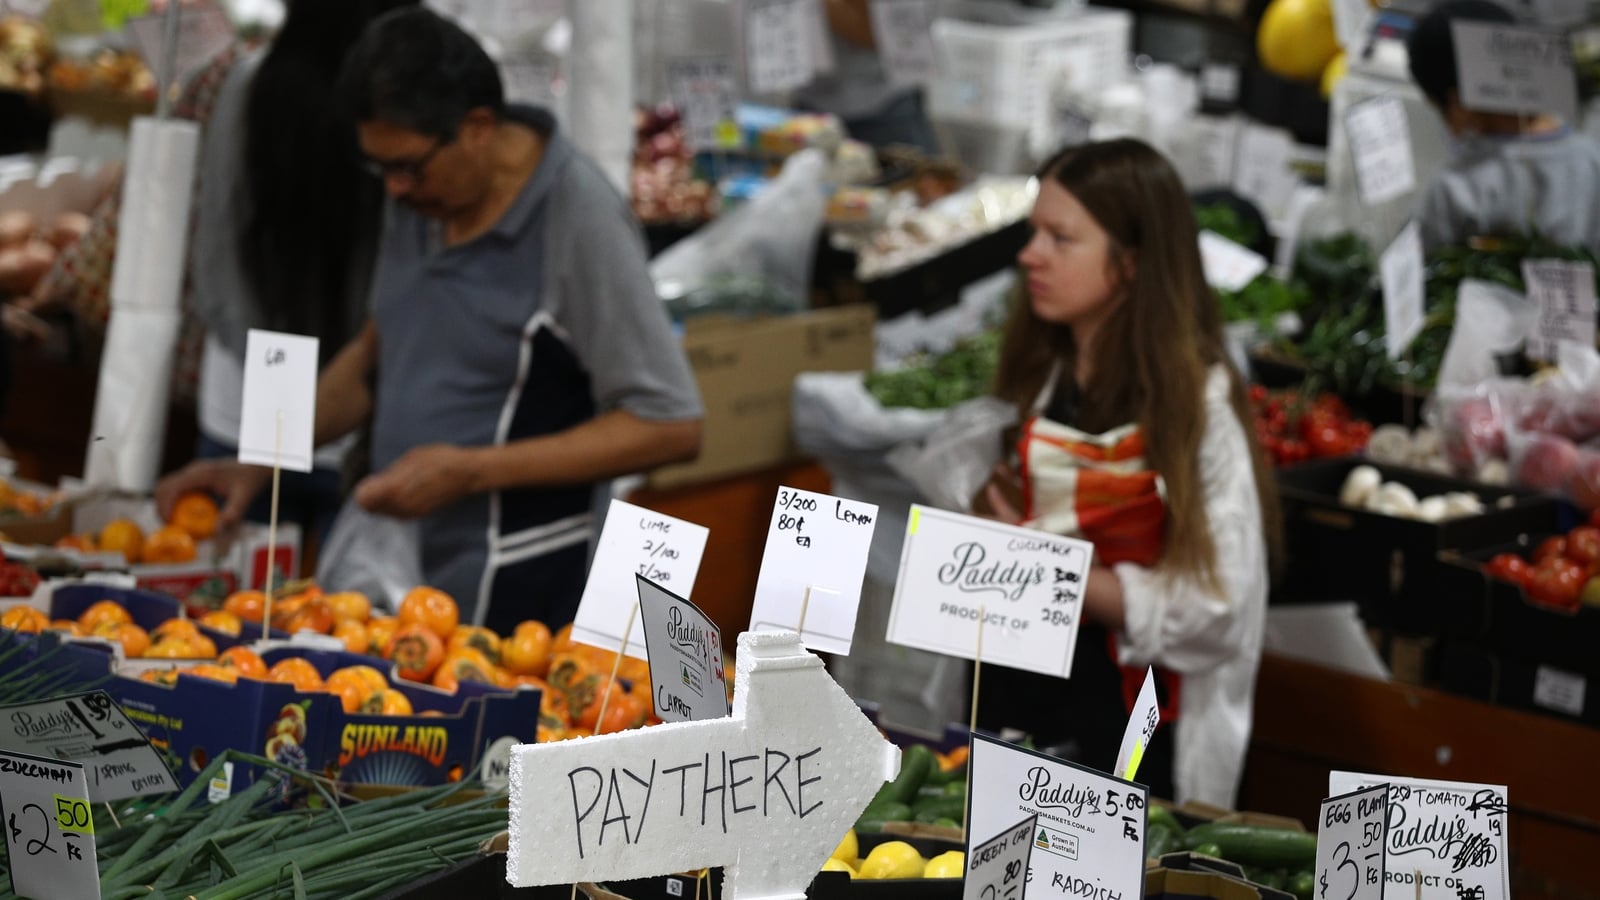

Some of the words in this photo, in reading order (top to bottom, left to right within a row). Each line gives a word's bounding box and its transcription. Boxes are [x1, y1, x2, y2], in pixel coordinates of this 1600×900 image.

[779, 490, 817, 512] 3/200
[938, 542, 1045, 601] Paddy's
[940, 602, 1007, 627] PRODUCT
[1011, 618, 1030, 630] OF
[667, 606, 704, 656] Paddy's
[658, 685, 692, 721] CARROT
[11, 709, 73, 737] Paddy's
[338, 723, 448, 768] SUNLAND
[1019, 766, 1096, 818] Paddy's
[1413, 789, 1467, 807] TOMATO
[568, 759, 656, 859] PAY
[1018, 805, 1096, 834] PADDYSMARKETS.COM.AU
[1325, 803, 1351, 828] EGG
[1051, 834, 1069, 845] Grown
[1051, 842, 1075, 854] Australia
[971, 838, 1007, 870] GREEN
[1385, 872, 1440, 887] RODUCT
